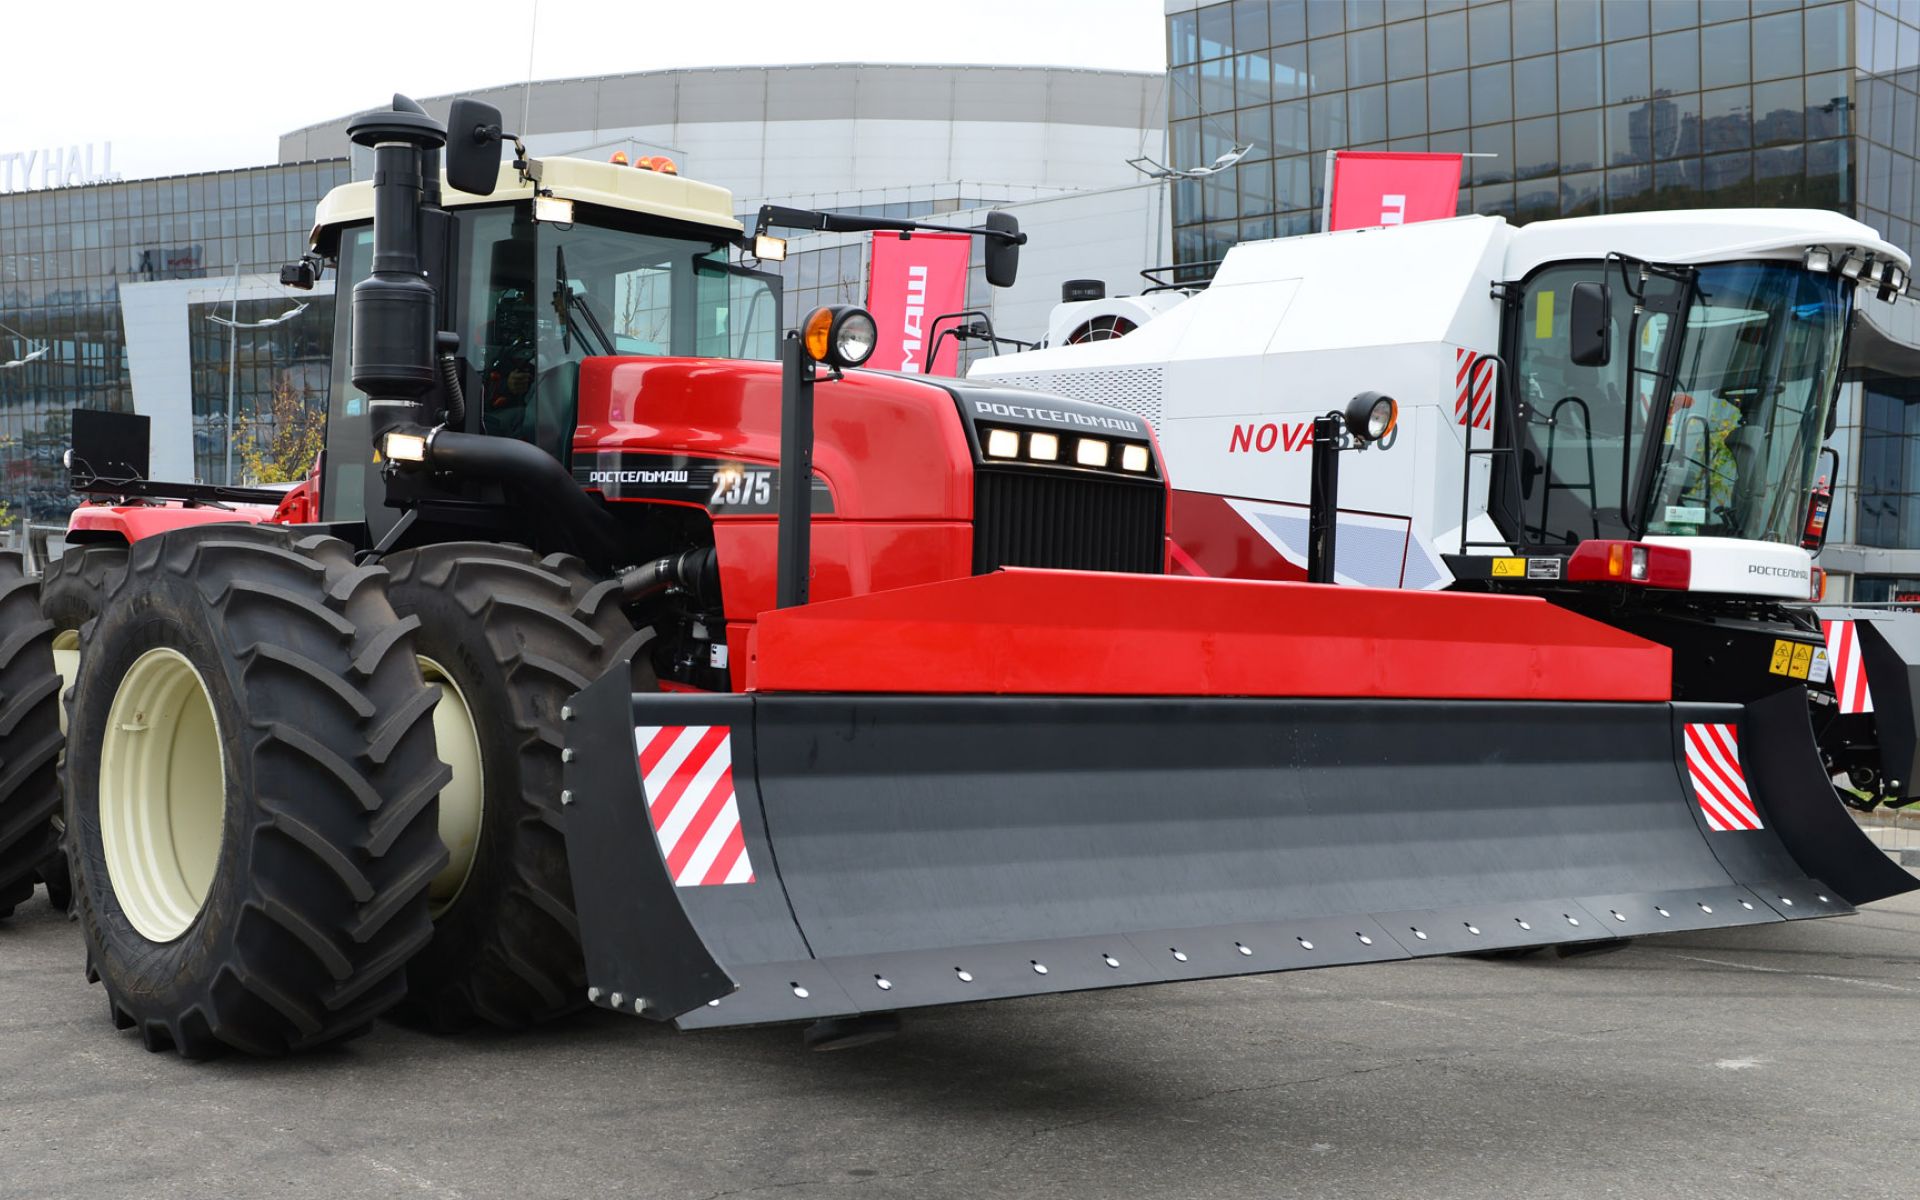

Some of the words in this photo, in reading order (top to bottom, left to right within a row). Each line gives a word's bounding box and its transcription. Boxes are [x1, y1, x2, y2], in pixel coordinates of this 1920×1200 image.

[42, 141, 121, 187] HALL
[975, 401, 1138, 433] РОСТСЕЛЬМАШ
[590, 470, 688, 483] РОСТСЕЛЬМАШ
[711, 472, 771, 505] 2375
